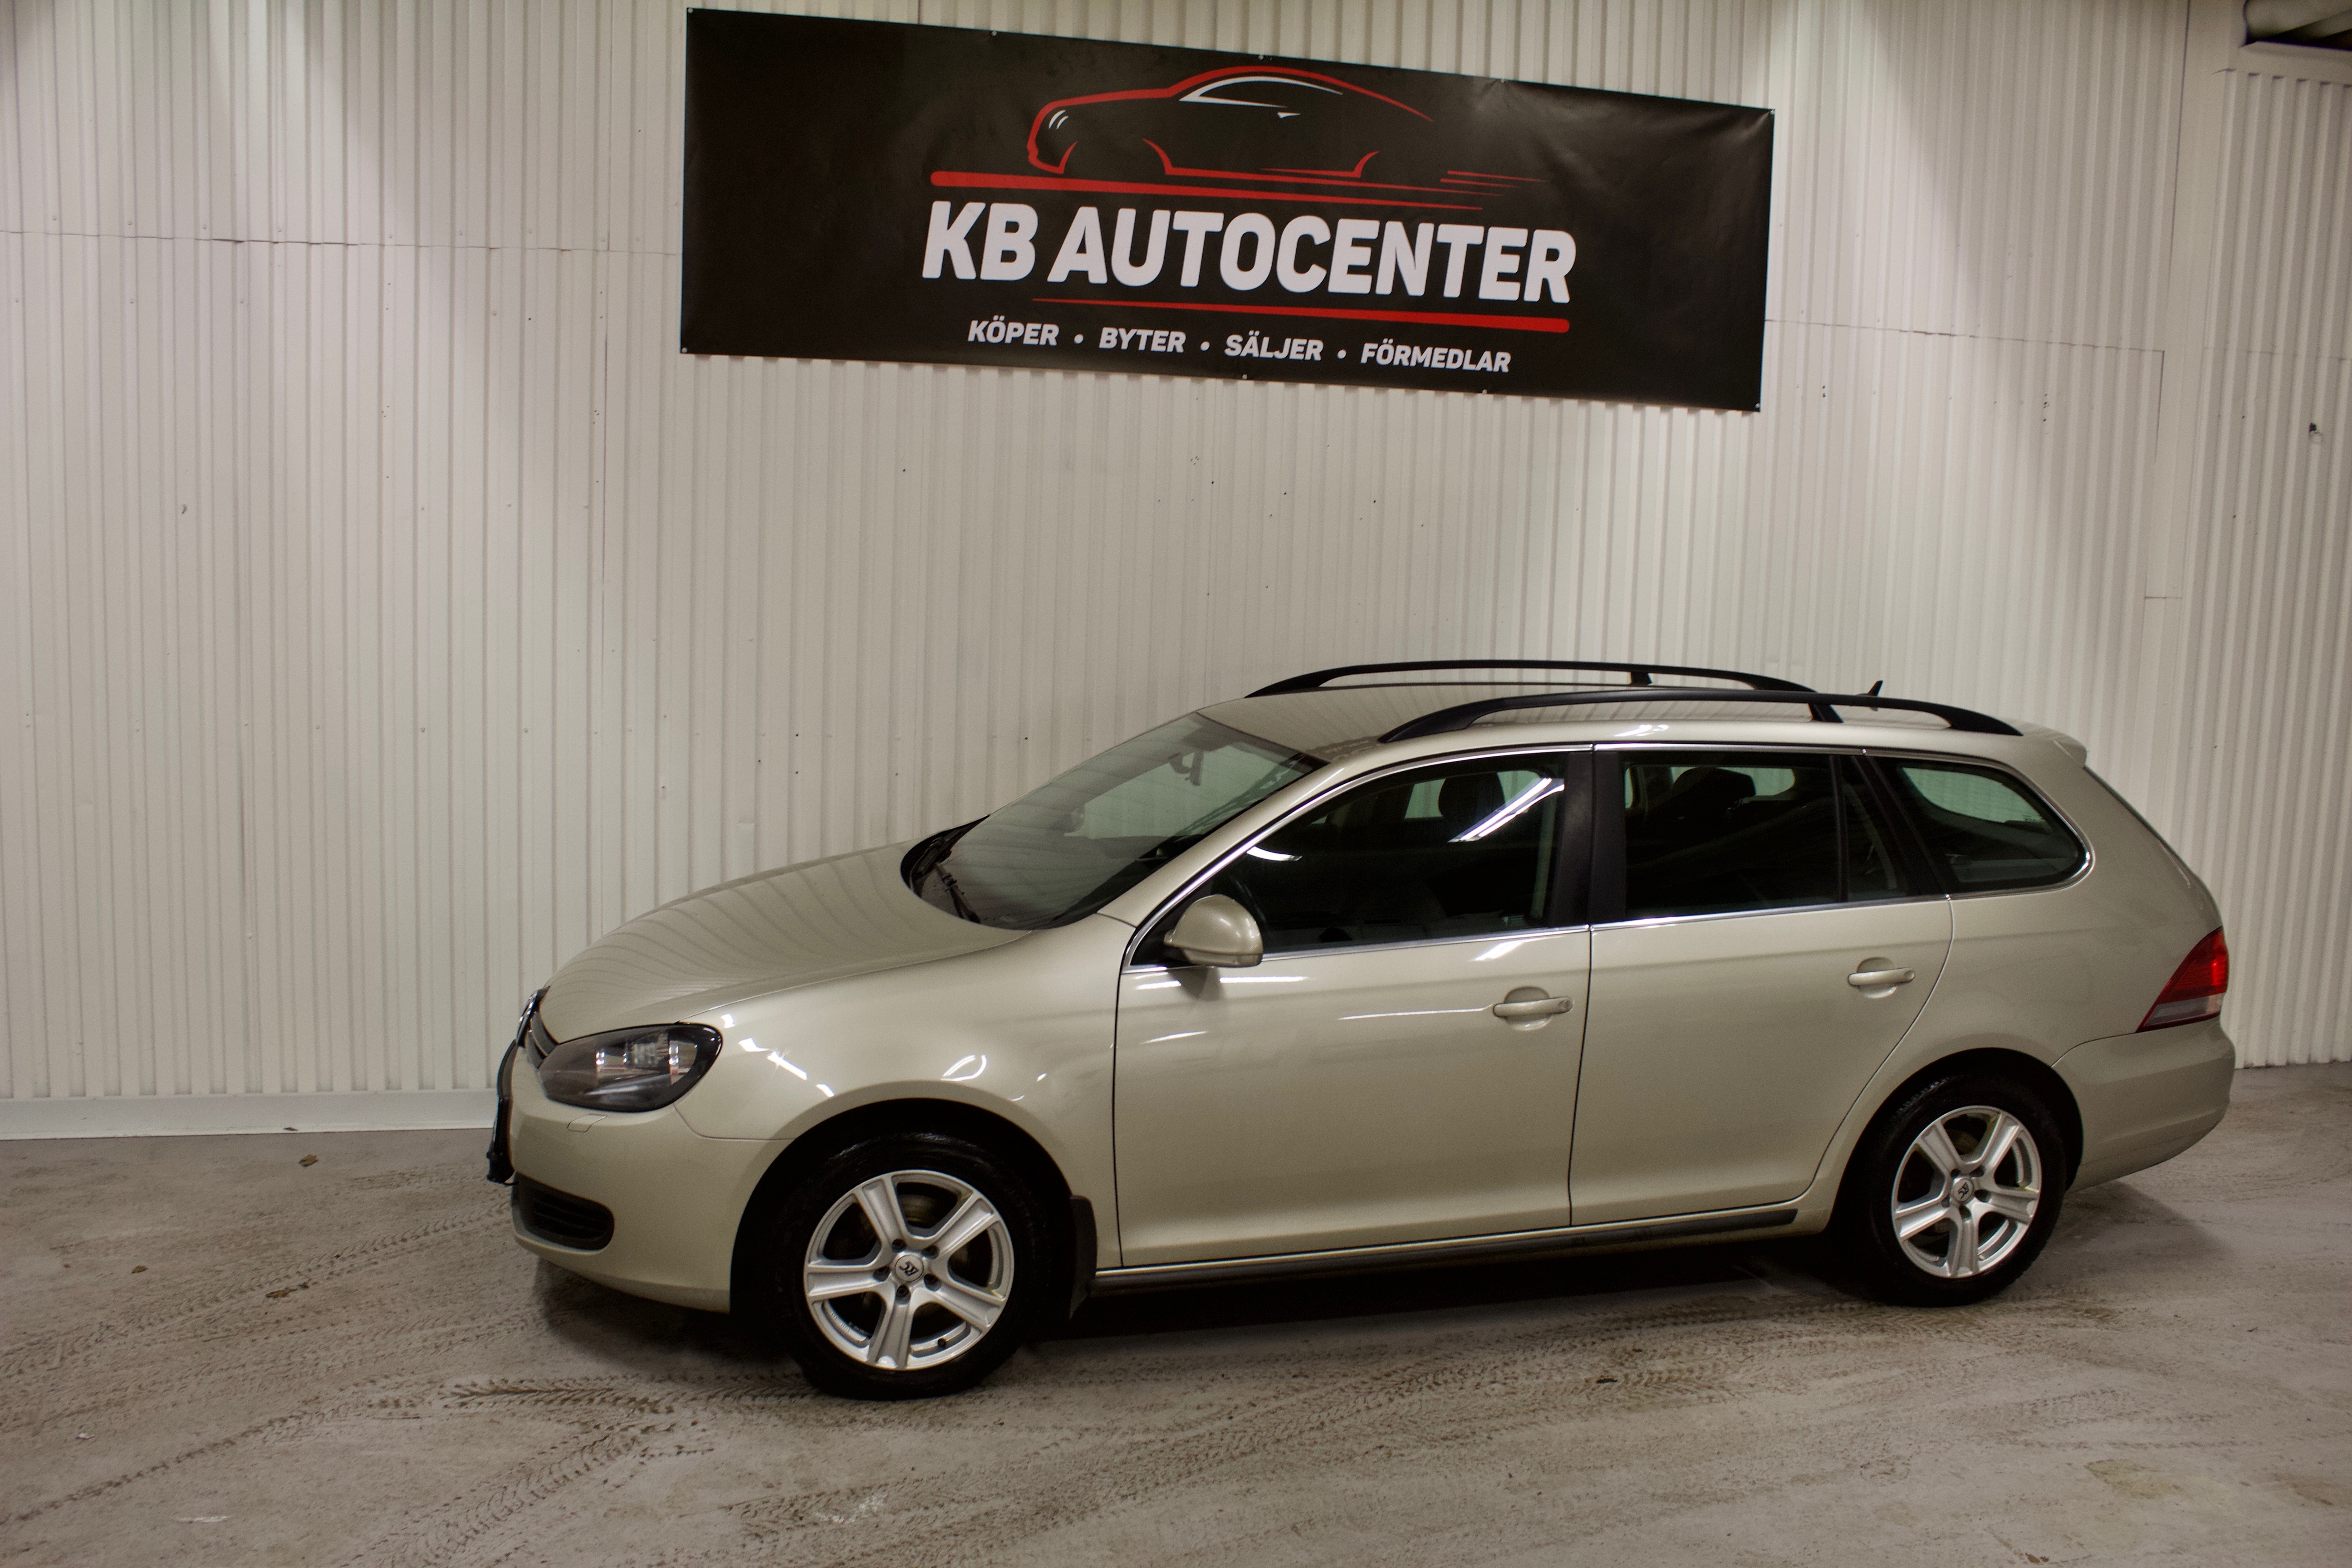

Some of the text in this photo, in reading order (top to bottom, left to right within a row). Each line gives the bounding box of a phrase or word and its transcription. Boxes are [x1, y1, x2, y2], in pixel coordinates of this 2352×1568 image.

[922, 201, 1576, 303] KB AUTOCENTER
[968, 315, 1511, 372] KÖPER BYTER SÄLJER FÖRMEDLAR
